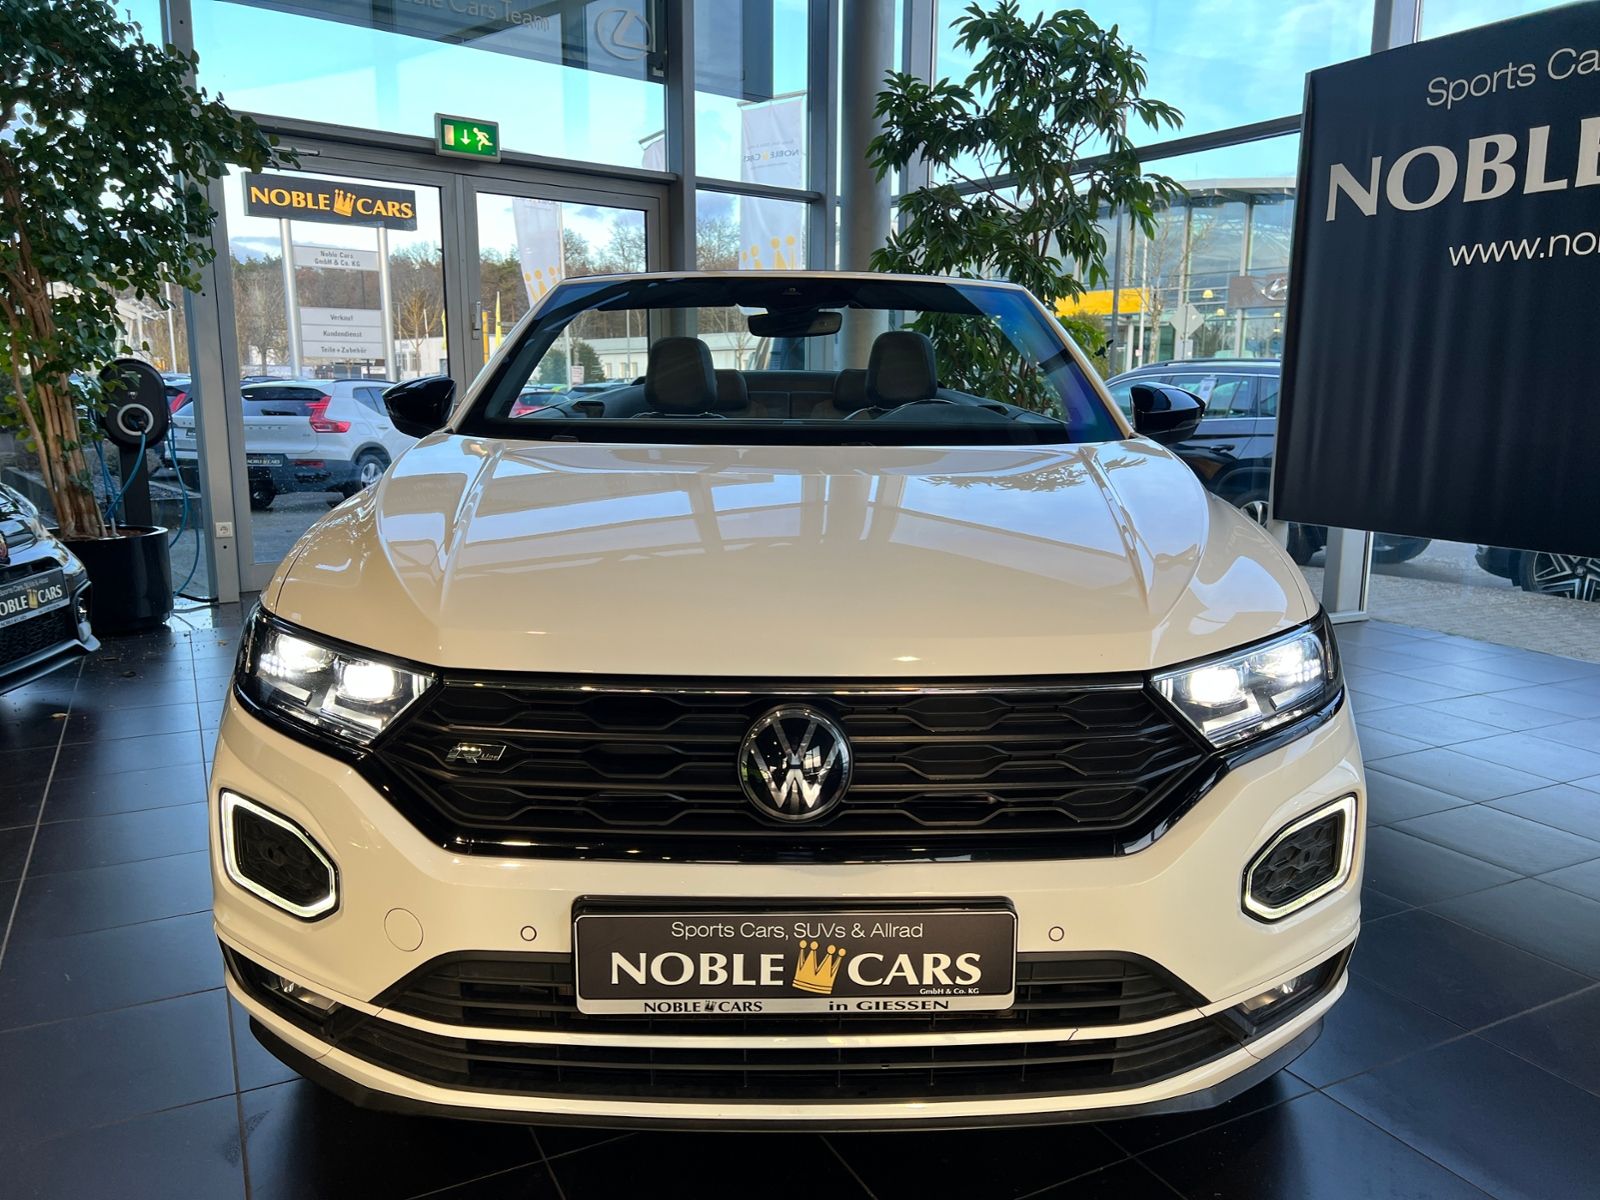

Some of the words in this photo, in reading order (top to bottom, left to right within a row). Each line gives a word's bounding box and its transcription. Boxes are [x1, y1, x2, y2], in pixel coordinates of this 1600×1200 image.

[1426, 62, 1536, 110] Sports
[1547, 47, 1600, 80] Ca
[250, 187, 330, 210] NOBLE
[356, 198, 413, 219] CARS
[320, 250, 338, 258] Noble
[1449, 231, 1600, 267] www.no
[330, 313, 354, 321] Verkauf
[0, 594, 28, 616] OBLE
[38, 584, 63, 603] CARS
[671, 921, 735, 940] Sports
[740, 922, 789, 940] Cars,
[793, 922, 847, 938] SUVs
[851, 922, 866, 938] &
[870, 922, 924, 938] Allrad
[611, 951, 785, 986] NOBLE
[847, 952, 982, 986] CARS
[919, 987, 944, 995] GmbH
[953, 987, 966, 995] Co.
[644, 1001, 701, 1013] NOBLE
[718, 1001, 763, 1012] CARS
[828, 1001, 848, 1011] in
[856, 1001, 949, 1011] GIESSEN
